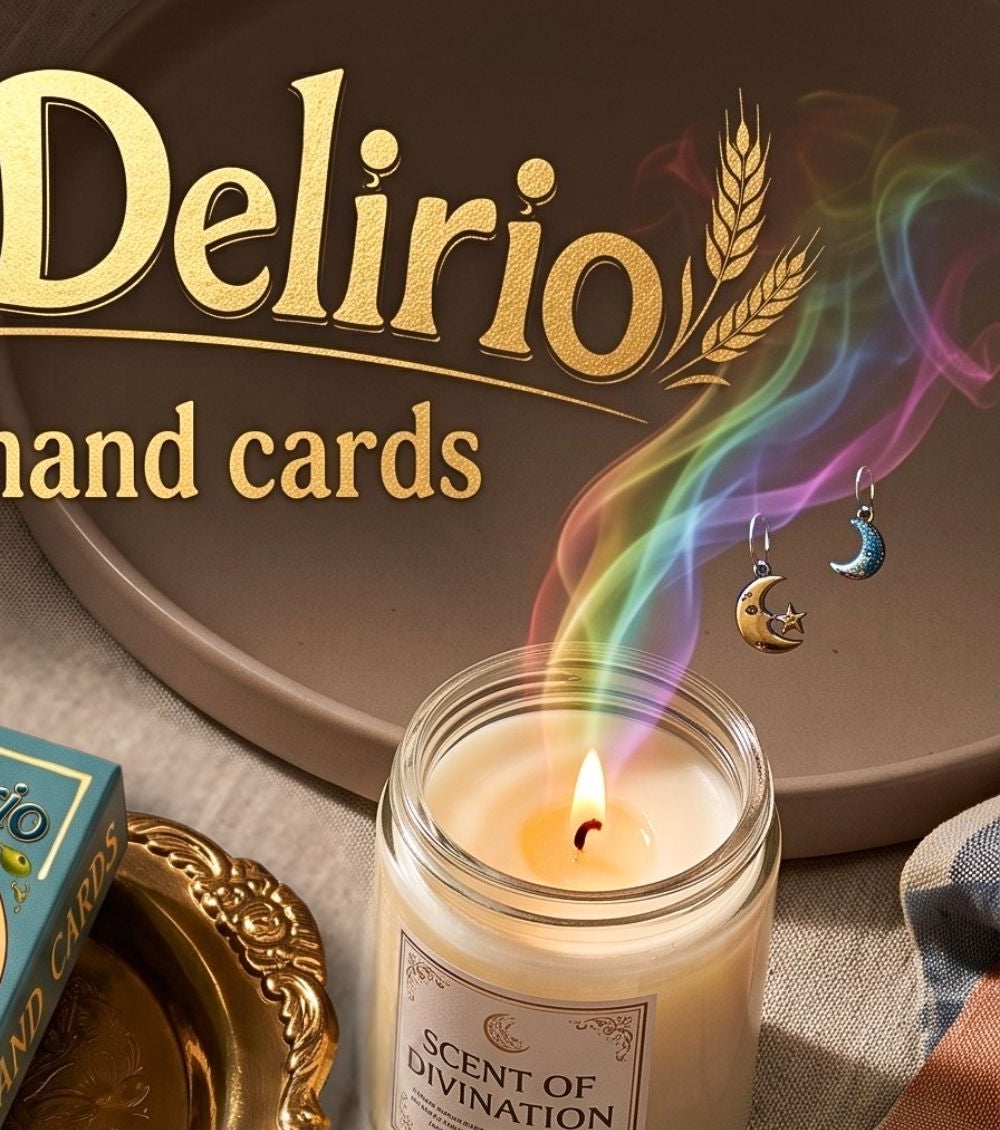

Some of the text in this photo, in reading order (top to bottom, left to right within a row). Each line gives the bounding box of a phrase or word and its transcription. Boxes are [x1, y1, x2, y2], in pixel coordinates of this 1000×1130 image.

[50, 820, 118, 981] CARDS
[407, 1045, 615, 1130] DIVINATION
[423, 1029, 596, 1099] SCENT OF
